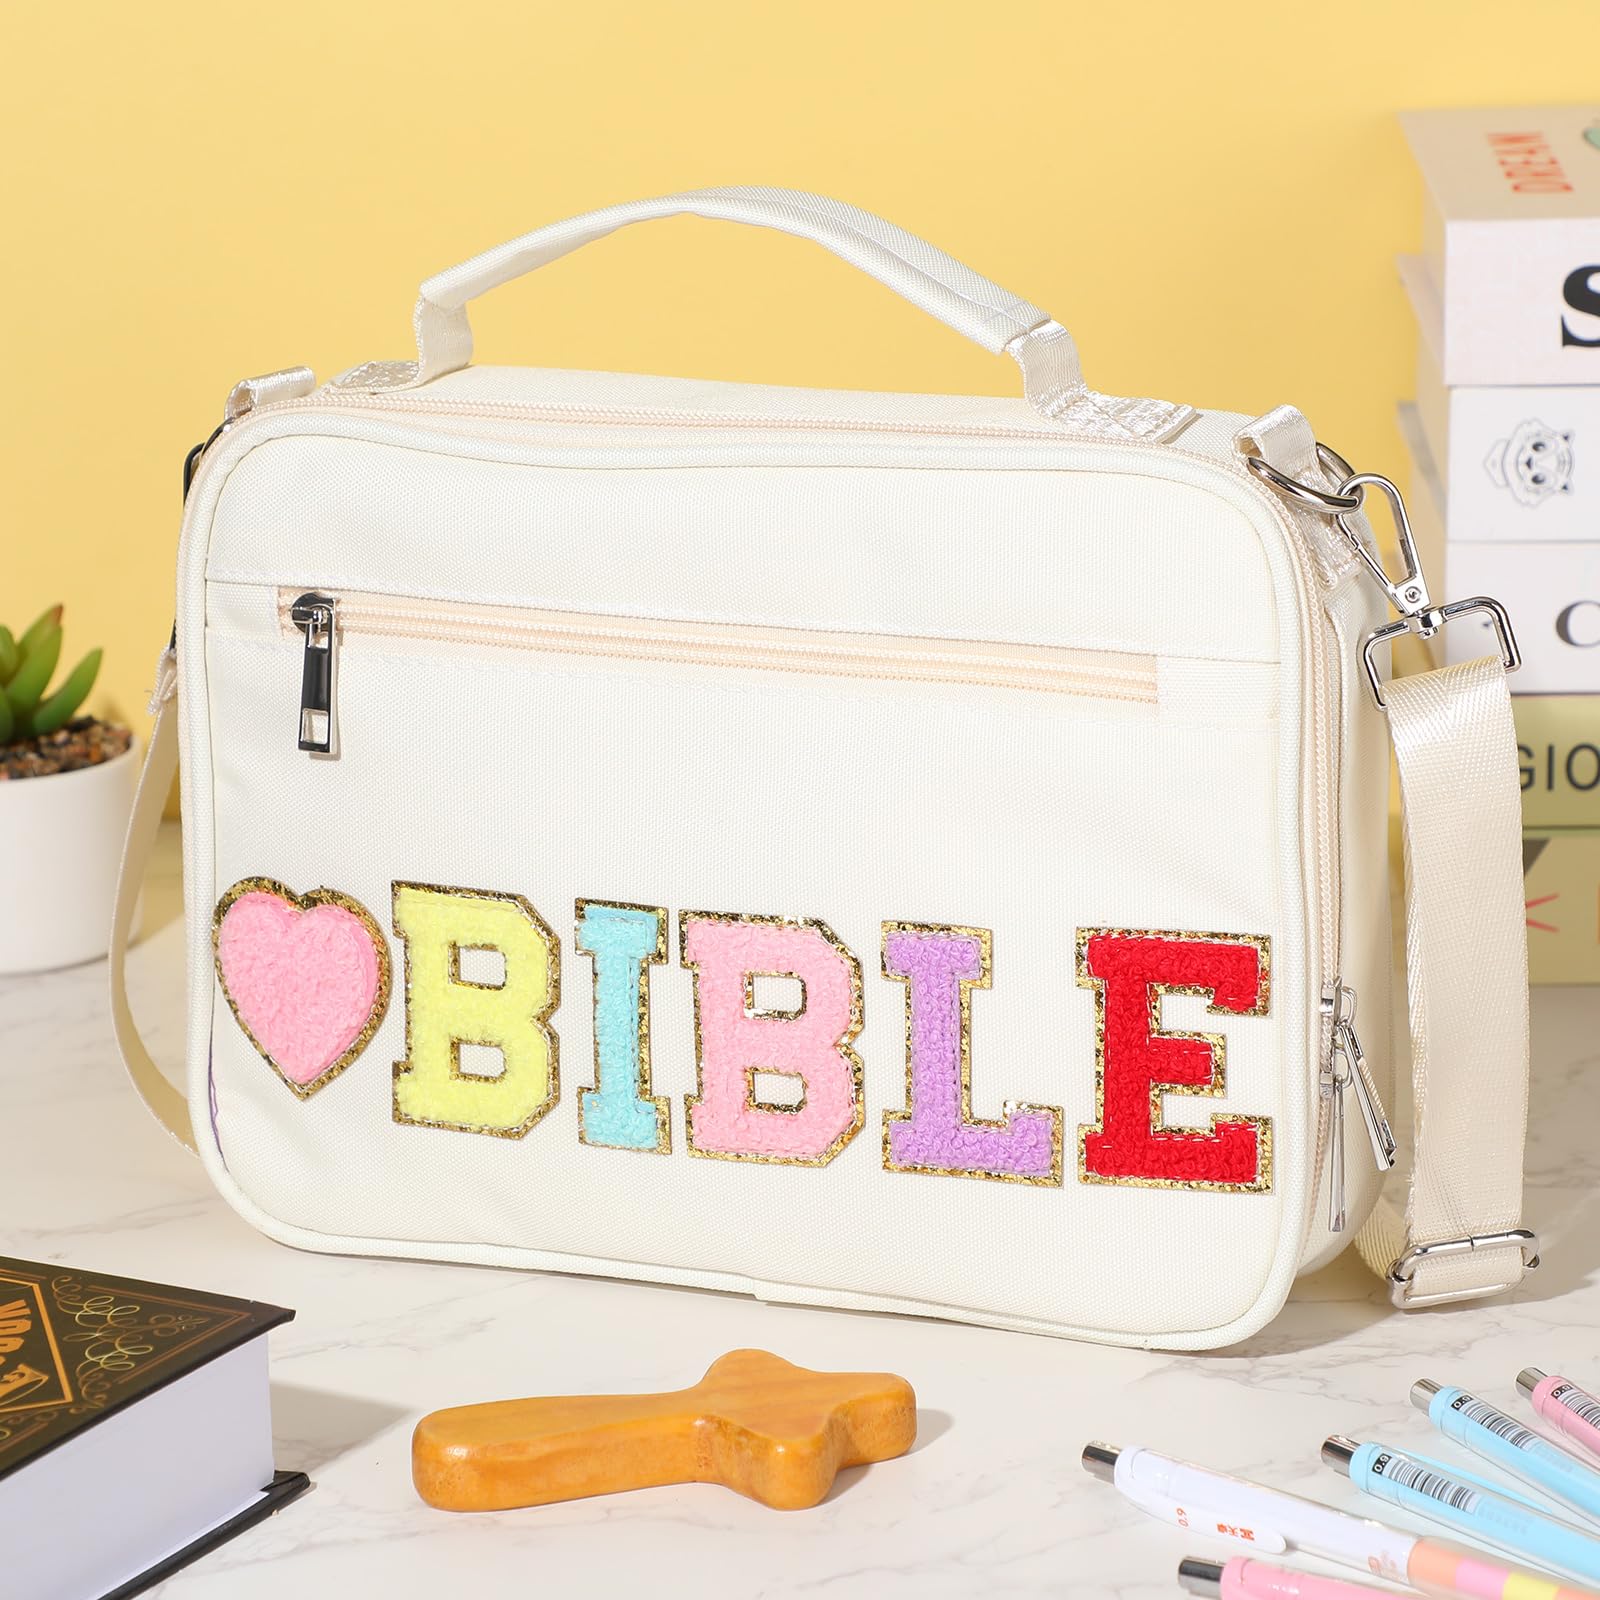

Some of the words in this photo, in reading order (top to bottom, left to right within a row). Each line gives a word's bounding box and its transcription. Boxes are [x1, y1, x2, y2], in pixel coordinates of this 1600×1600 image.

[392, 880, 1275, 1195] BIBLE
[1373, 1454, 1390, 1473] 0.9
[1176, 1507, 1189, 1528] 0.9
